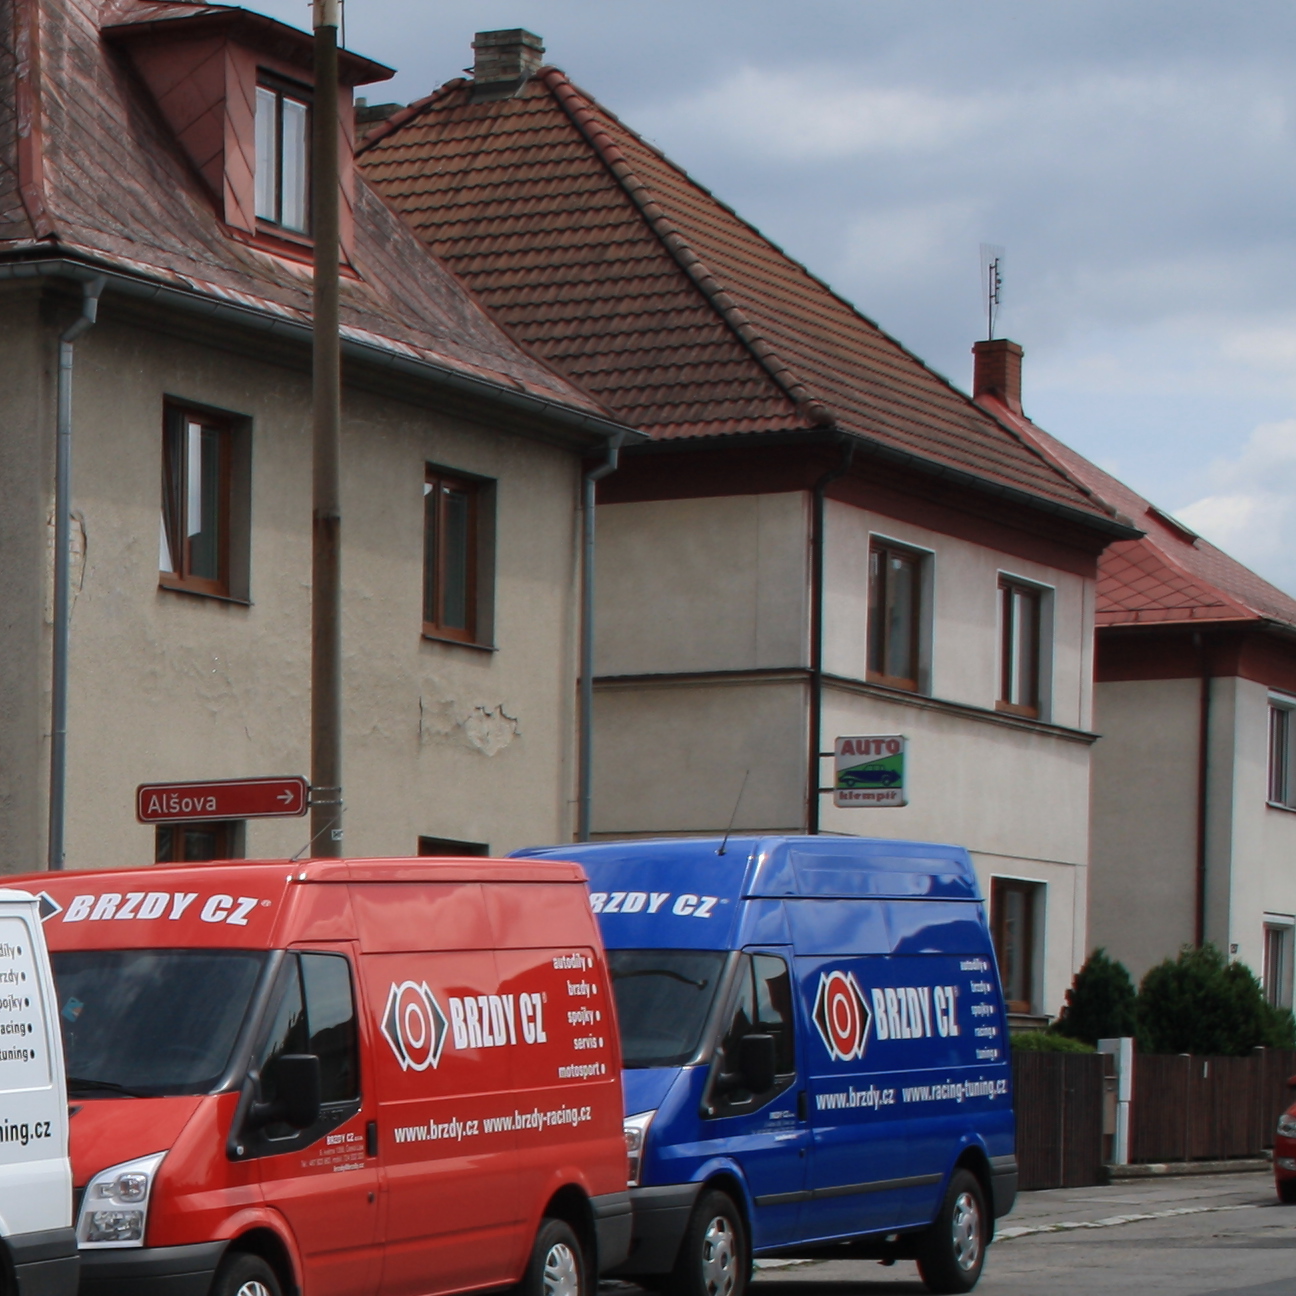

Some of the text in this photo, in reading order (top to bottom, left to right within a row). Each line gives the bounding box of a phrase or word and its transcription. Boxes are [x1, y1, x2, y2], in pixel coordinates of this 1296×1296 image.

[841, 739, 900, 755] AUTO
[147, 793, 217, 814] Alšova
[62, 892, 259, 926] BRZDY CZ
[589, 892, 718, 918] RZDY CZ
[567, 980, 590, 998] brzdy
[449, 992, 547, 1049] BRZDY CZ
[567, 1007, 594, 1026] spojky
[871, 986, 958, 1040] BRZDY CZ
[573, 1034, 597, 1049] servis
[816, 1076, 1007, 1111] www.brzdy.cz www.racing-tuning.cz
[394, 1104, 592, 1143] www.brzdy.cz www.brzdy-racing.cz
